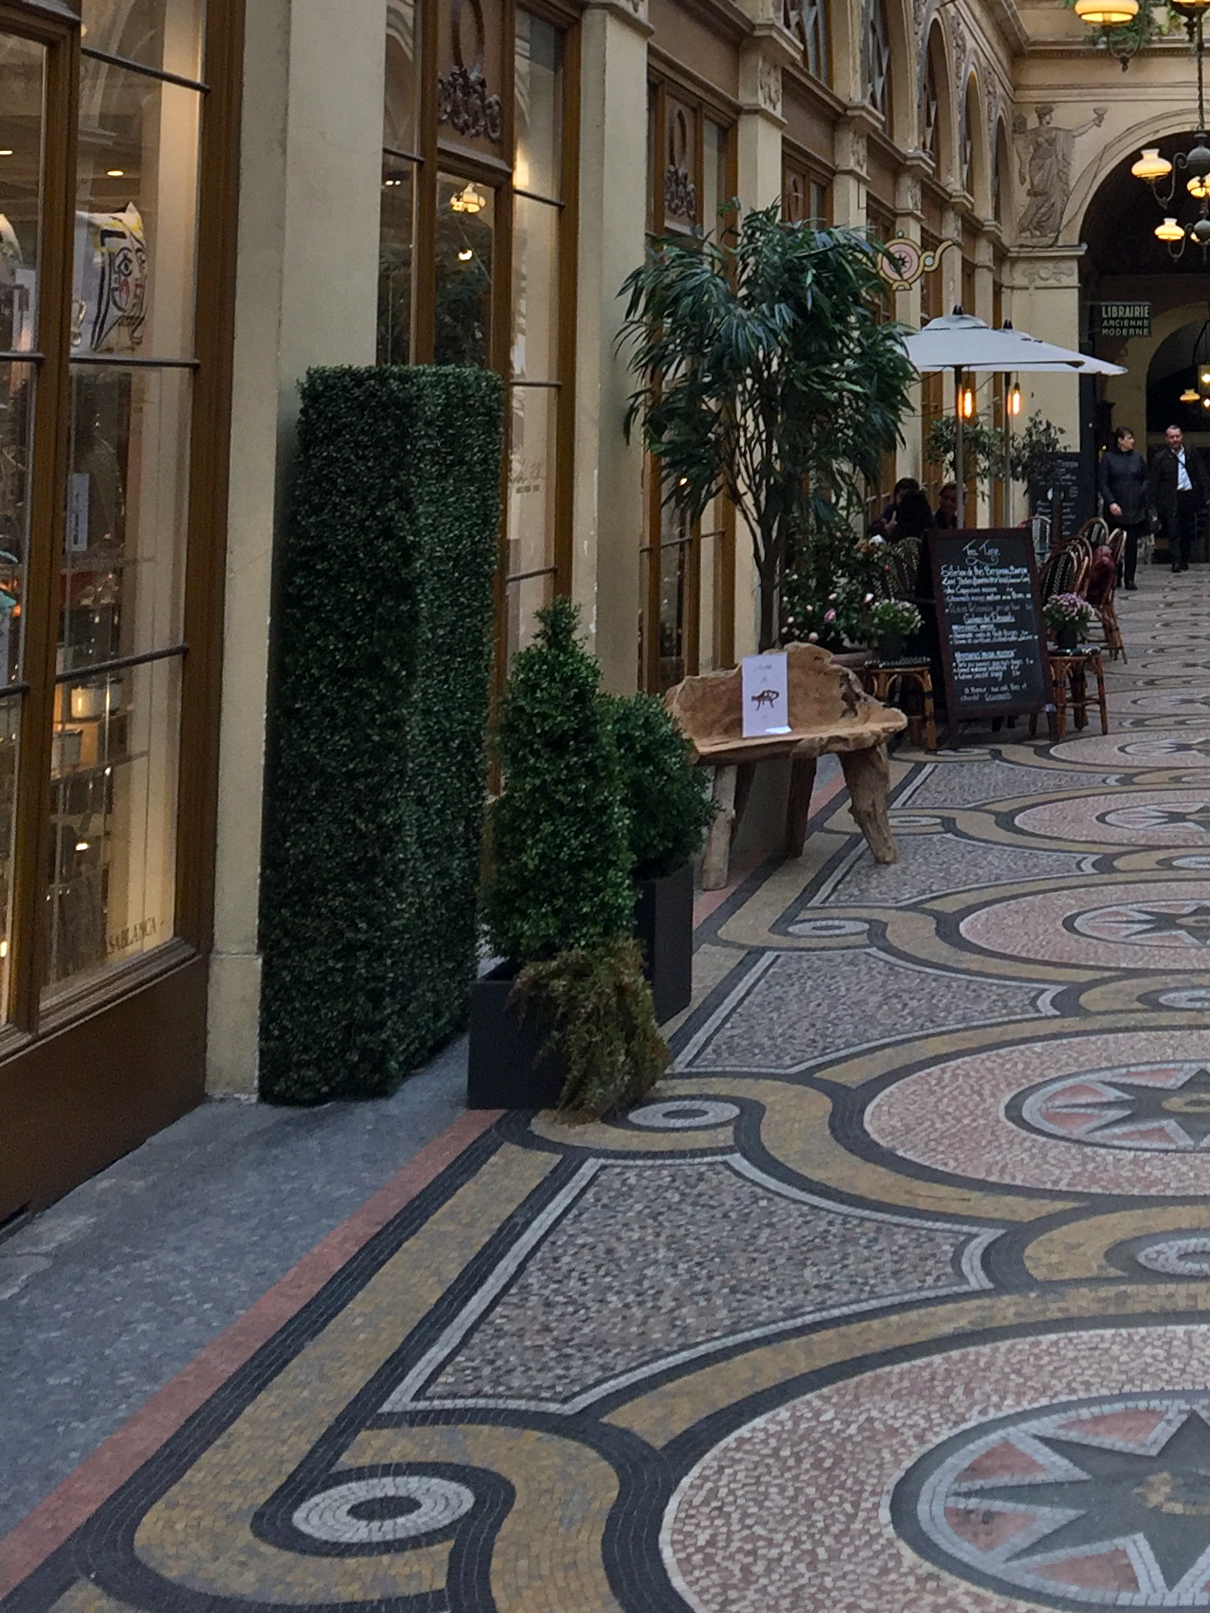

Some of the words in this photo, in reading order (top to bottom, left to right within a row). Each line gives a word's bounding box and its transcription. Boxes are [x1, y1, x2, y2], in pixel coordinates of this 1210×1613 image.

[1101, 305, 1150, 318] LIBRAIRIE
[1101, 319, 1150, 327] ANCIENNE
[1101, 328, 1149, 336] MODERNE
